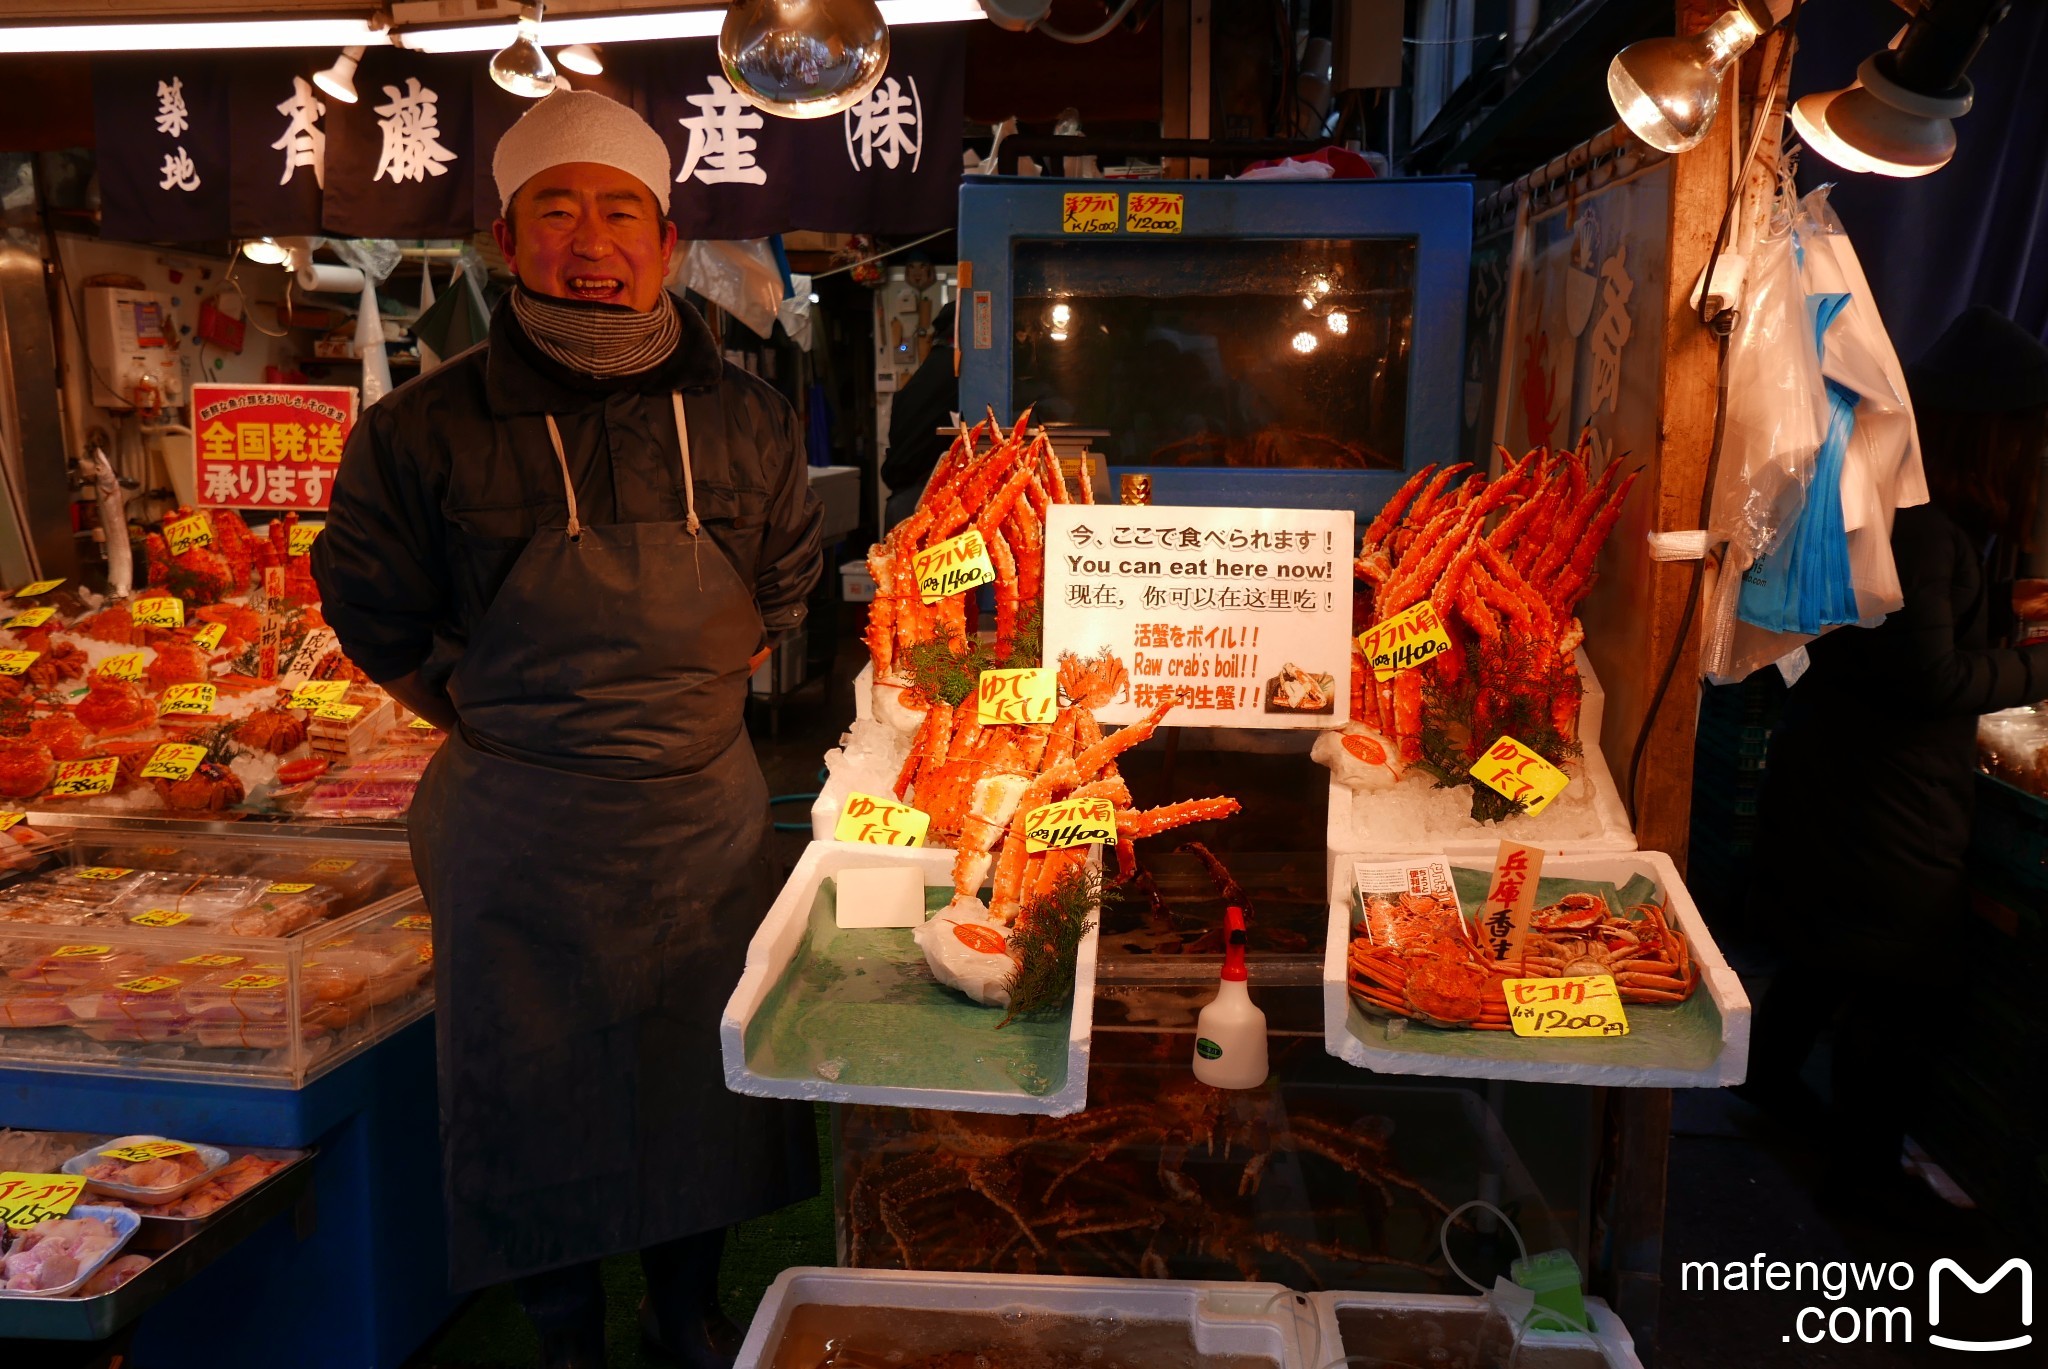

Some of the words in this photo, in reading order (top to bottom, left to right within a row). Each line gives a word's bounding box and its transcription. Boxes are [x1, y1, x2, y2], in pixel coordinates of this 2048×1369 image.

[155, 76, 201, 191] 築地
[201, 421, 344, 463] 全国発送
[1068, 555, 1110, 573] You
[1118, 558, 1161, 575] can
[1169, 559, 1207, 576] eat
[1216, 559, 1268, 578] here
[1277, 561, 1333, 579] now!
[1134, 652, 1163, 676] Raw
[1167, 653, 1210, 678] crab's
[981, 671, 1037, 703] ゆで
[1490, 742, 1550, 775] ゆで
[847, 798, 909, 826] ゆで
[1489, 850, 1528, 909] 兵庫
[1511, 977, 1613, 1005] セコガニ
